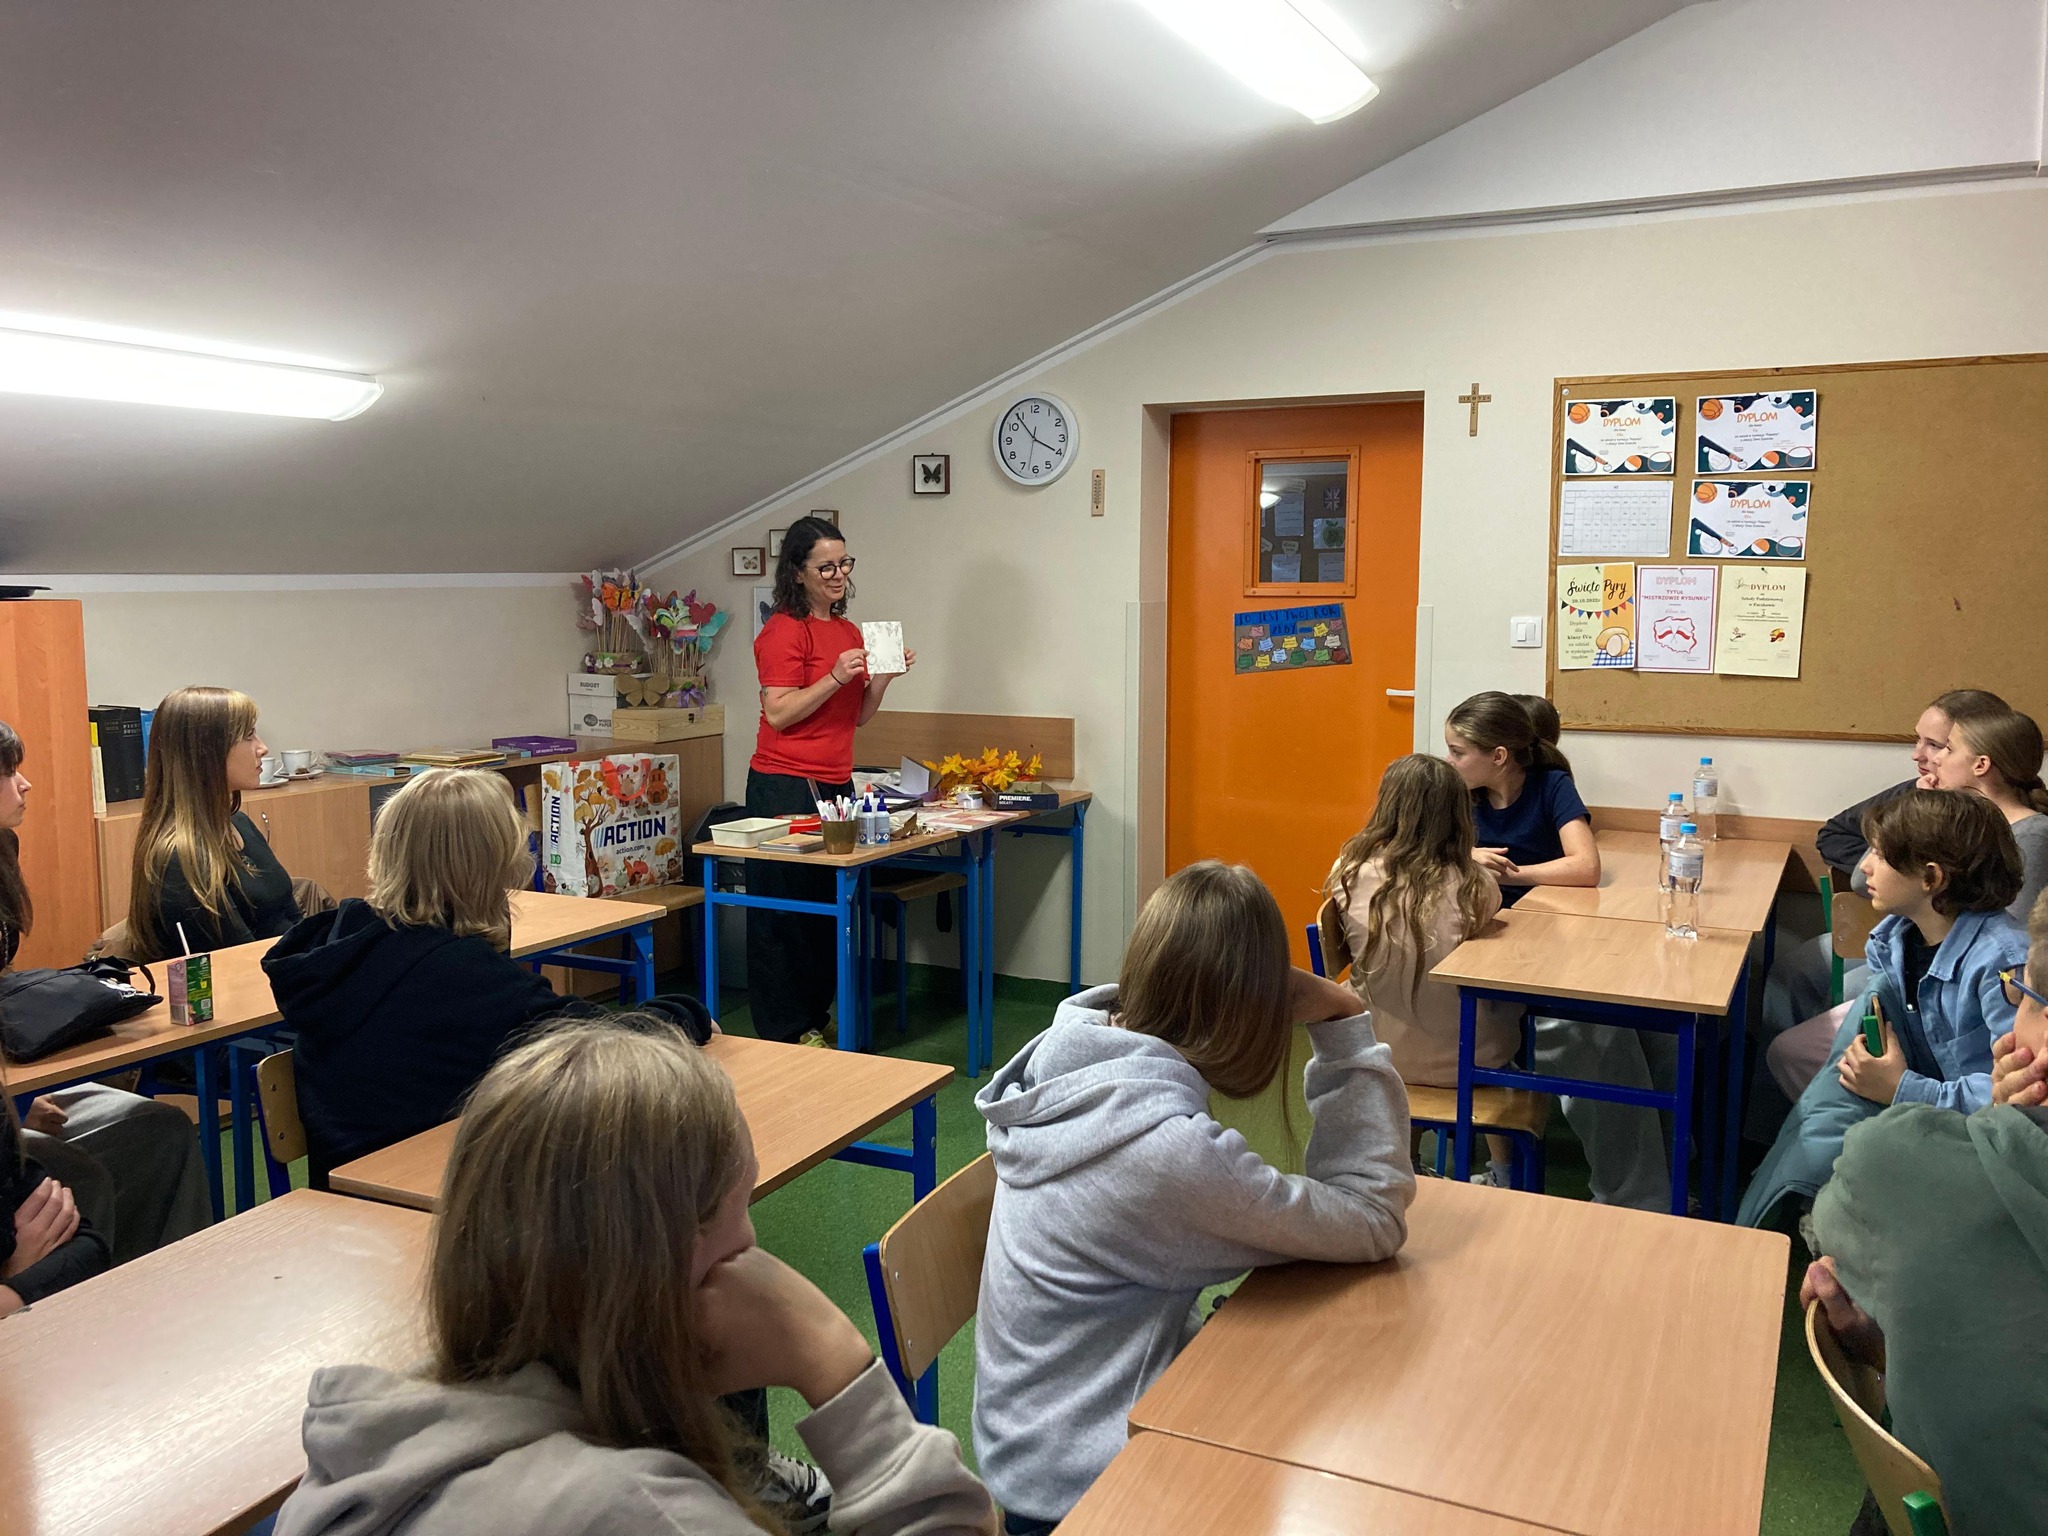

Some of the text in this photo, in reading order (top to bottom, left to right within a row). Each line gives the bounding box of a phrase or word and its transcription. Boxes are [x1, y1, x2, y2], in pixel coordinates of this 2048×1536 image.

[1030, 404, 1040, 413] 12
[1603, 417, 1641, 427] DYPLOM
[1737, 412, 1778, 423] DYPLOM
[1008, 422, 1020, 431] 10
[1054, 418, 1062, 427] 2
[1005, 436, 1013, 445] 9
[1058, 434, 1066, 443] 3
[1009, 451, 1017, 460] 8
[1055, 448, 1063, 456] 4
[1020, 461, 1027, 470] 7
[1044, 460, 1052, 469] 5
[1031, 465, 1040, 474] 6
[1730, 499, 1771, 509] DYPLOM
[1655, 576, 1697, 586] DYPLOM
[1567, 577, 1627, 600] Święto Pyry
[550, 795, 561, 844] ACTION
[603, 816, 666, 847] ACTION
[616, 844, 645, 855] action.com
